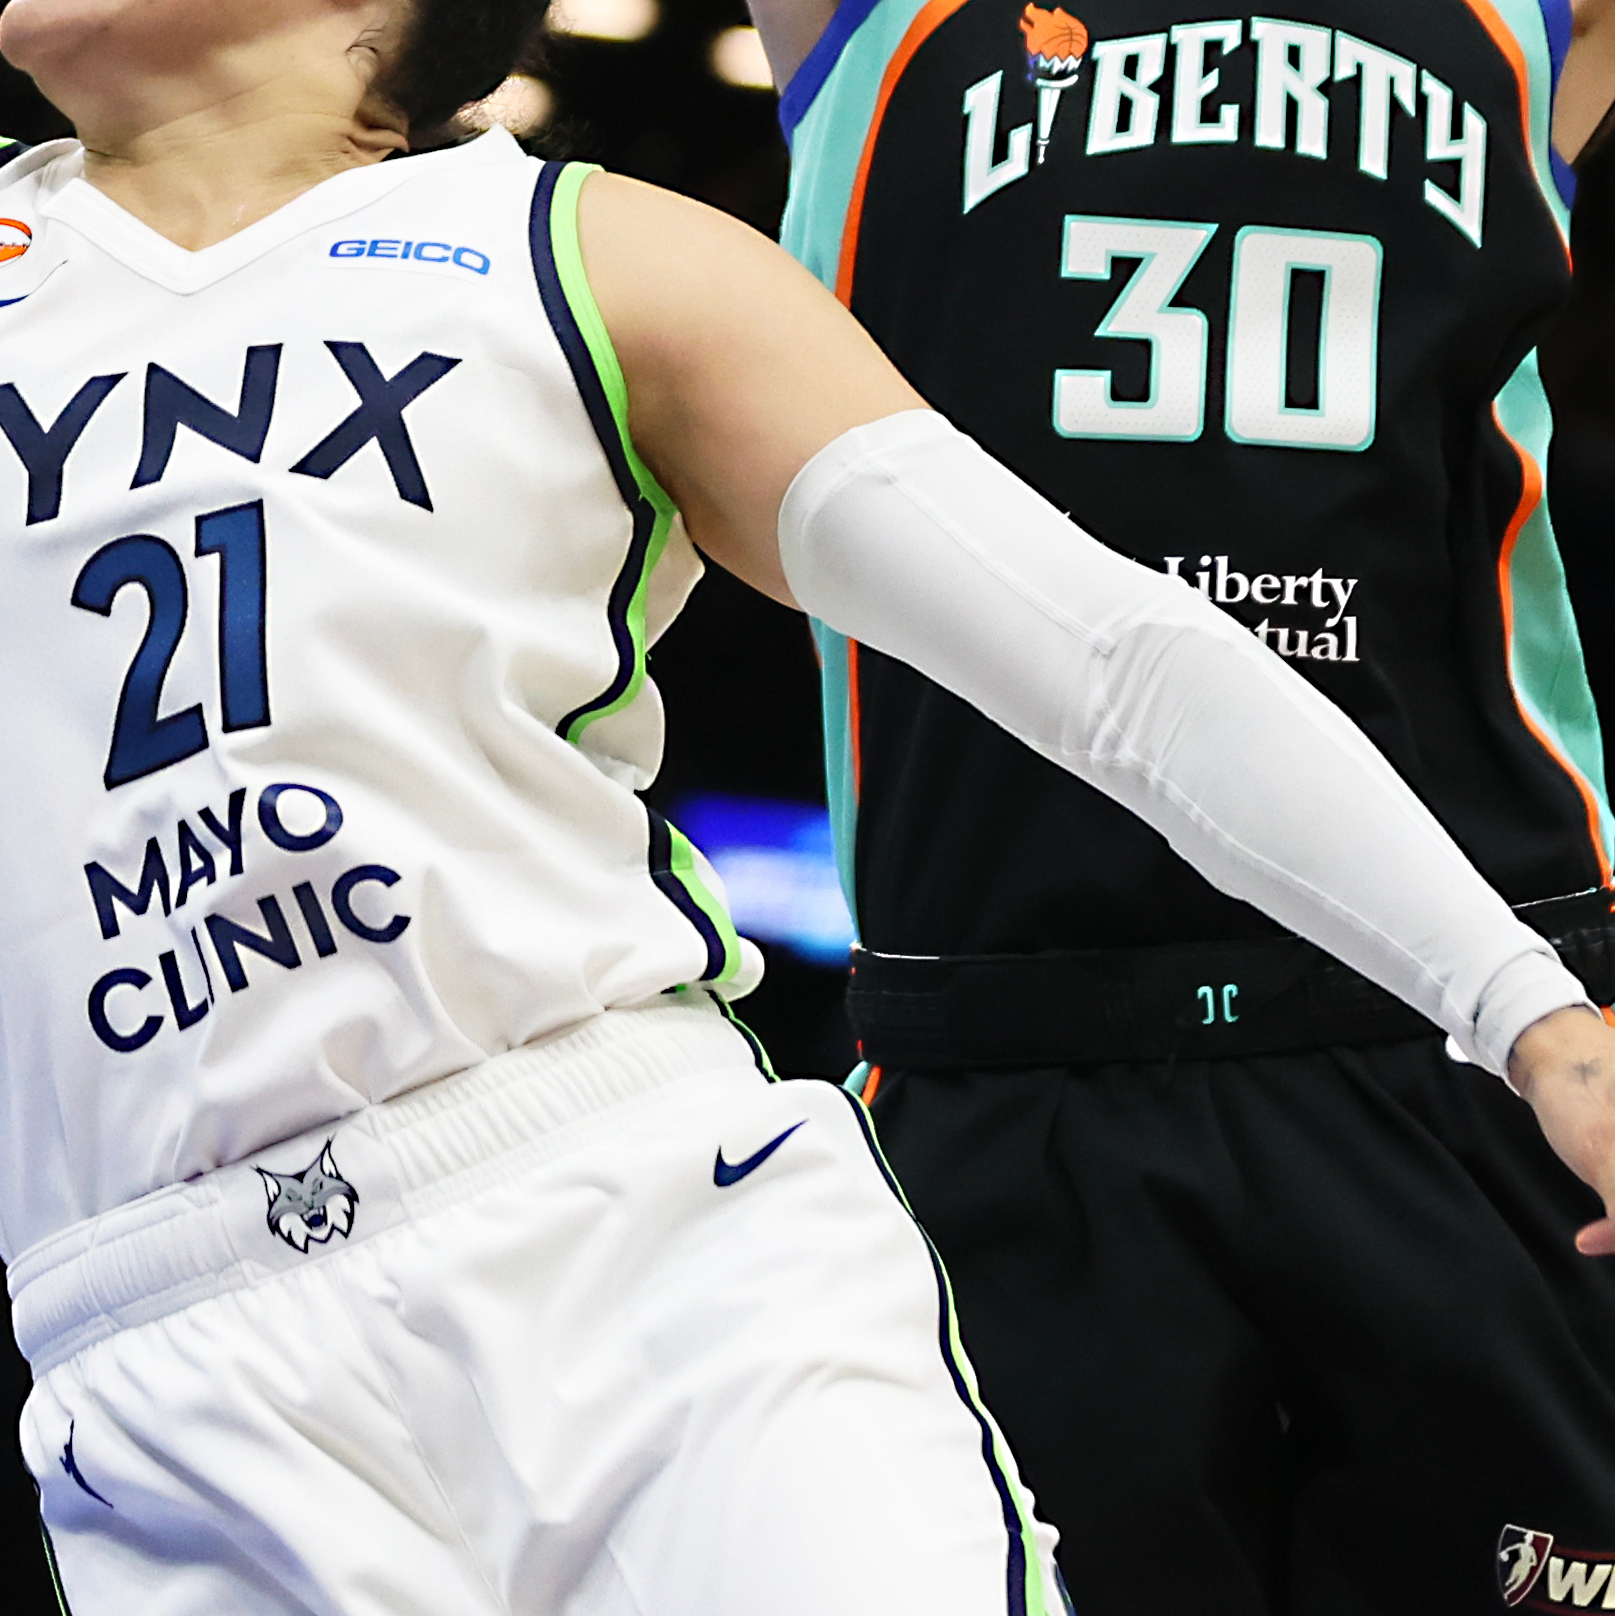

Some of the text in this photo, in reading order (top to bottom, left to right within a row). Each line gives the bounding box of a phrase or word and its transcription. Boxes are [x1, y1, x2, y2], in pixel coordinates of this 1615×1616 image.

[962, 16, 1488, 250] LIBERTY
[329, 239, 491, 276] GEICO
[1052, 214, 1385, 452] 30
[71, 497, 272, 792] 21
[1250, 615, 1361, 663] tual
[83, 783, 345, 941] MAYO
